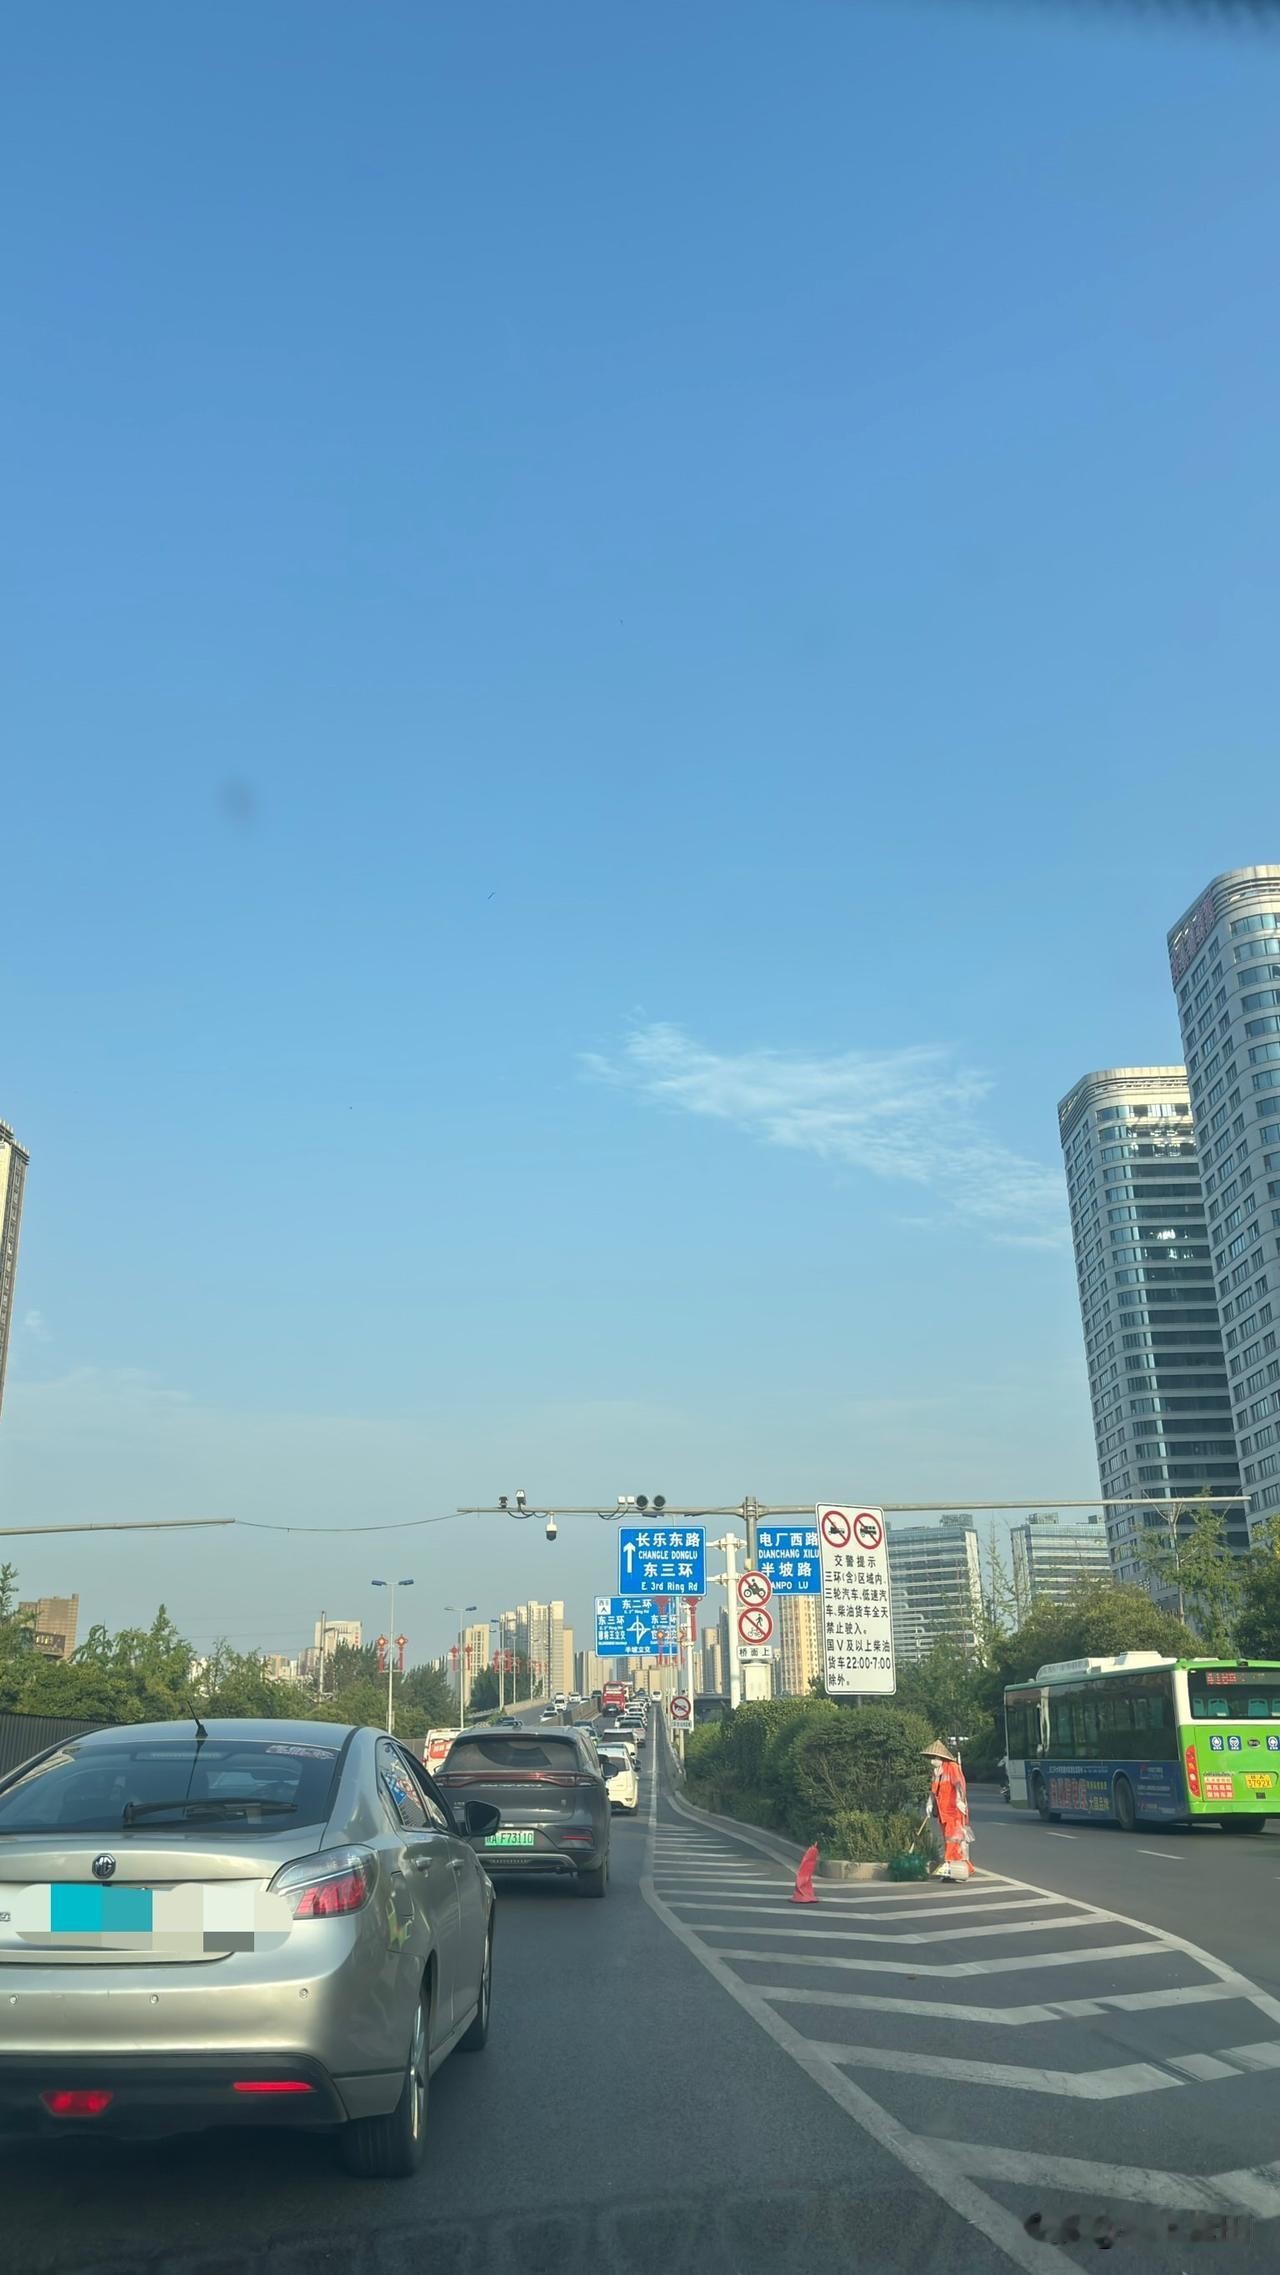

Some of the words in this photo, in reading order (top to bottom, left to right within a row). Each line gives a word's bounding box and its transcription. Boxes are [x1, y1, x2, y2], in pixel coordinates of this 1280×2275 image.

[636, 1532, 700, 1548] 长乐东路
[759, 1532, 818, 1547] 电厂西路
[638, 1550, 669, 1560] CHANGLE
[671, 1550, 698, 1560] DONGLU
[758, 1549, 800, 1559] DIANCHANG
[803, 1549, 820, 1559] XILU
[834, 1554, 876, 1568] 交警提示
[643, 1562, 693, 1578] 东三环
[761, 1562, 812, 1578] 半坡路
[651, 1581, 664, 1591] 3rd
[667, 1581, 685, 1594] Ring
[688, 1582, 698, 1592] Rd
[771, 1581, 793, 1590] ANPO
[798, 1581, 809, 1590] LU
[825, 1587, 887, 1602] 三轮汽车、低速汽
[622, 1598, 652, 1610] 东二环
[826, 1604, 889, 1618] 车、柴油货车全天
[598, 1615, 625, 1626] 东三环
[651, 1614, 677, 1625] 东三环
[826, 1621, 867, 1635] 禁止驶入。
[739, 1647, 770, 1657] 桥面上
[829, 1673, 850, 1687] 除外。
